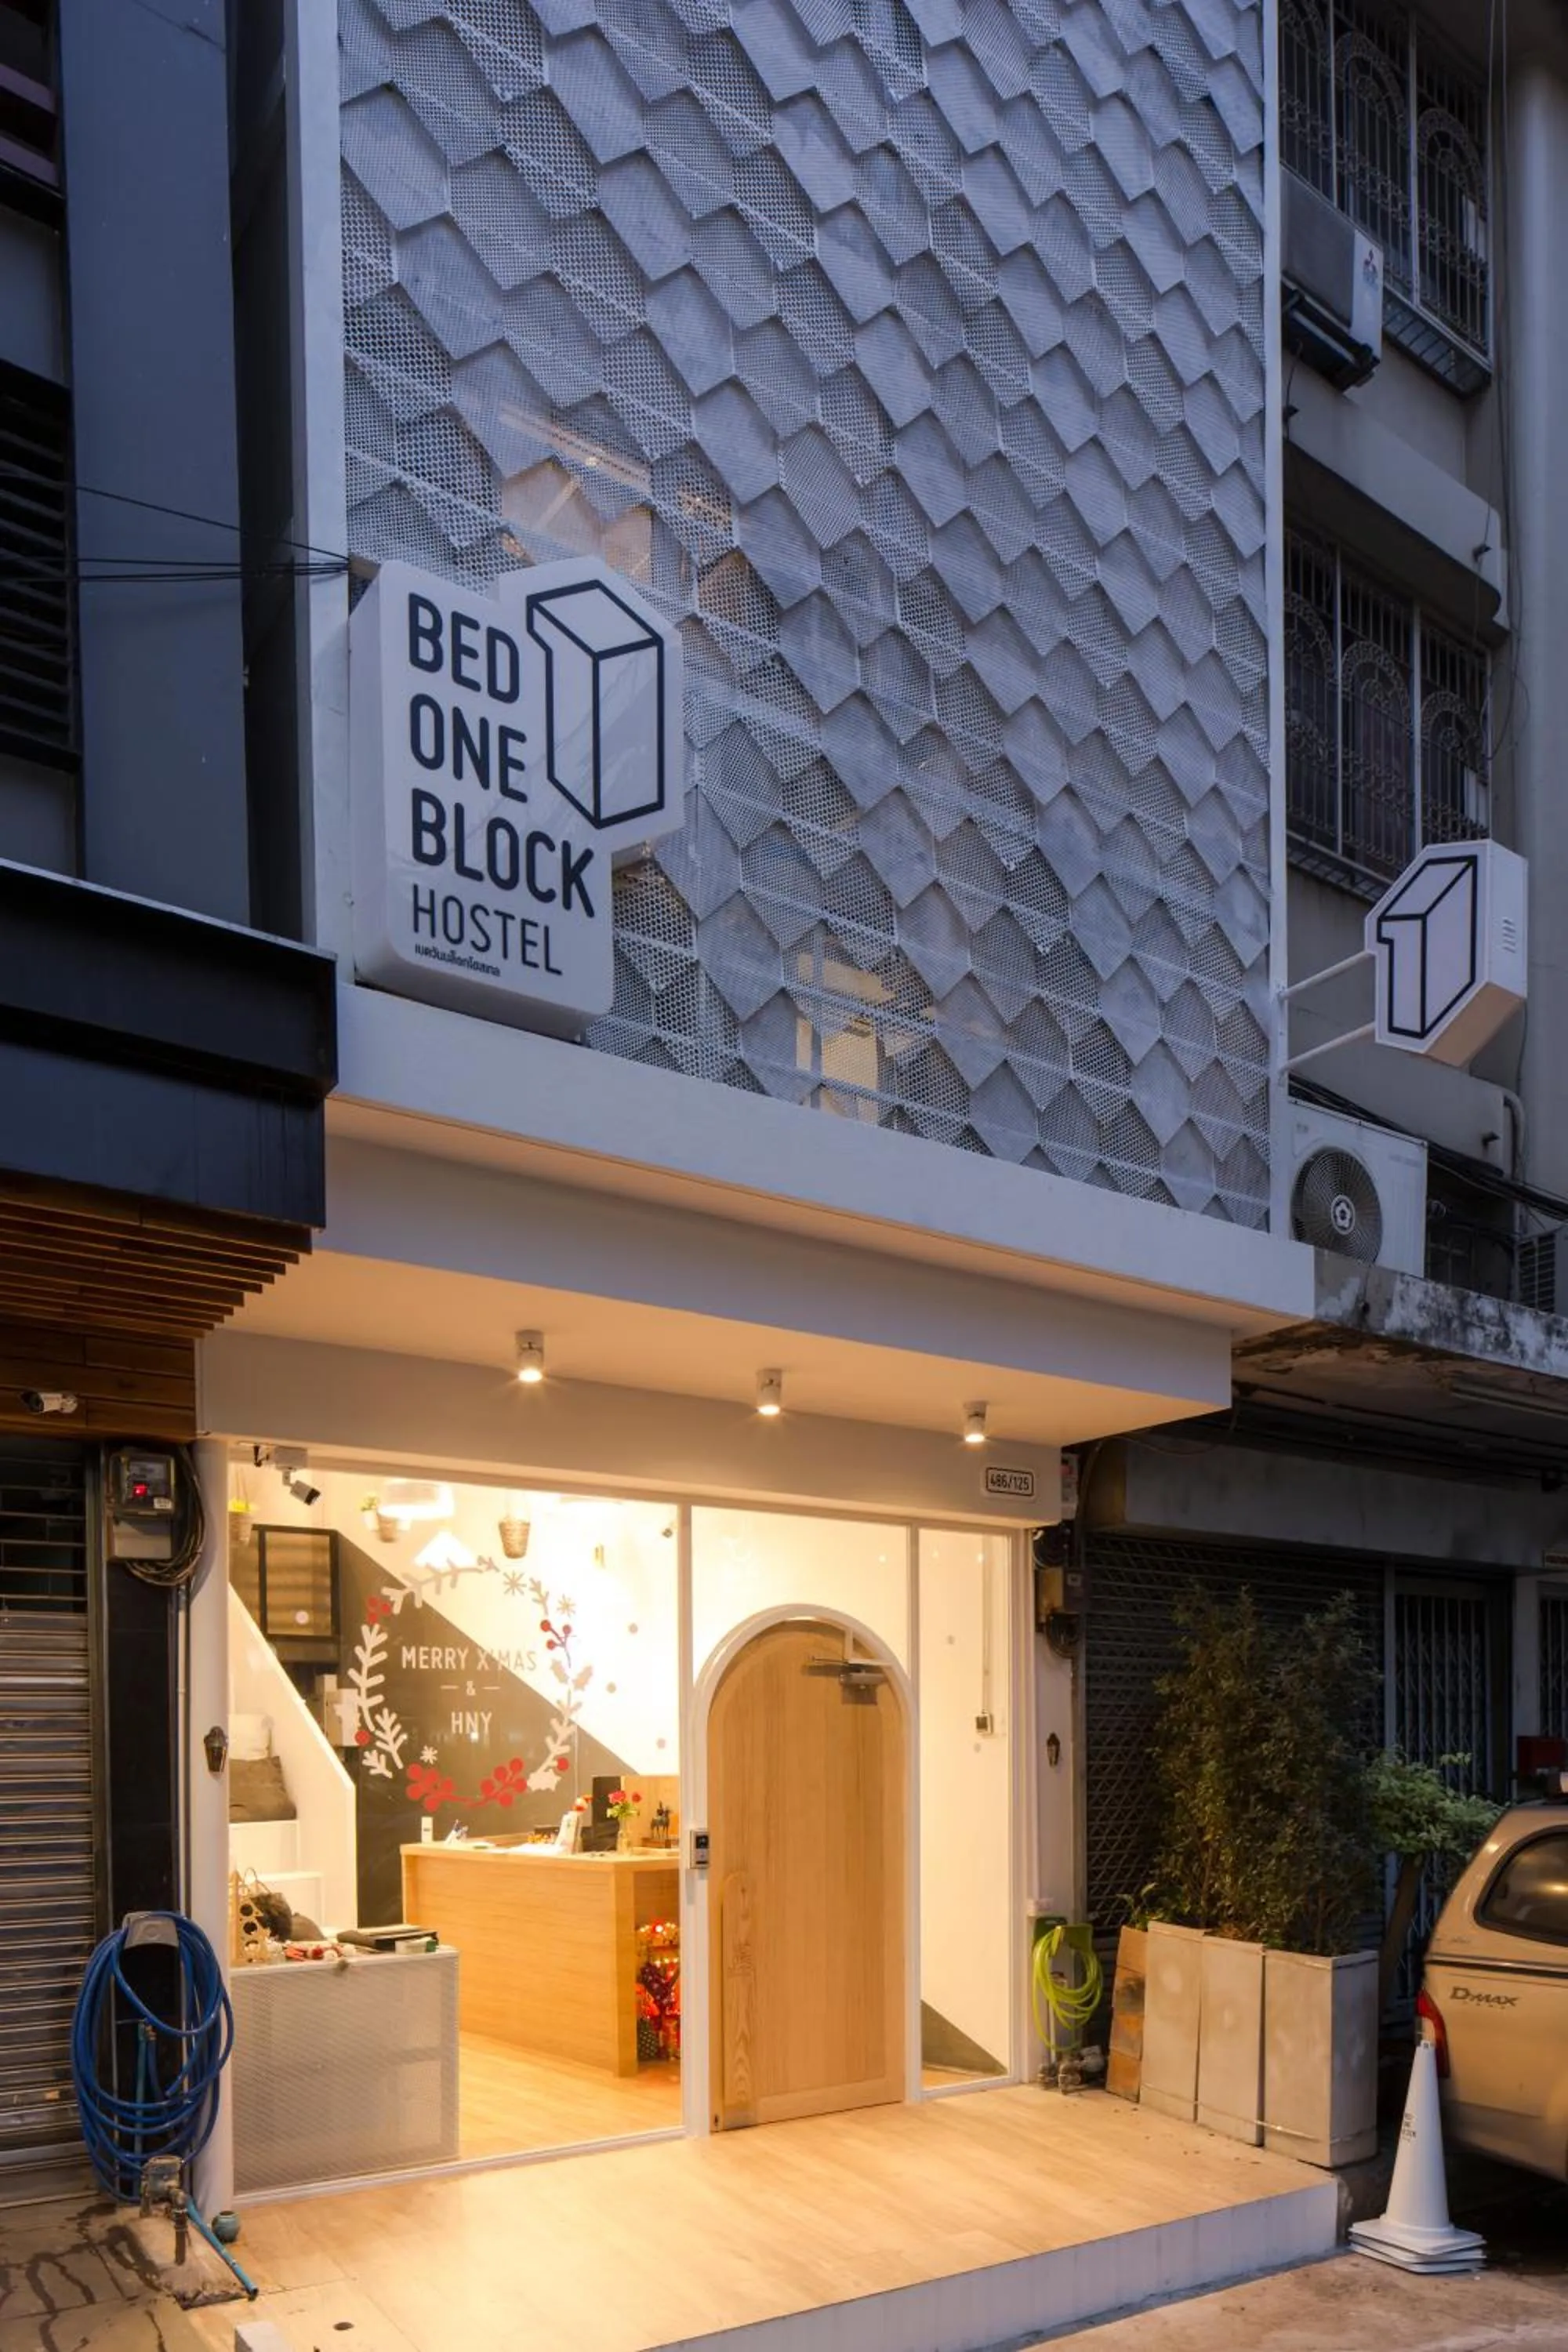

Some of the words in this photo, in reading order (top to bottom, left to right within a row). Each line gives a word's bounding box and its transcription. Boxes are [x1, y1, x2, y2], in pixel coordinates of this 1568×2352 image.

[408, 592, 519, 703] BED
[410, 693, 528, 803] ONE
[412, 788, 595, 917] BLOCK
[412, 884, 563, 976] HOSTEL
[401, 1646, 469, 1670] MERRY
[451, 1711, 492, 1734] HNY
